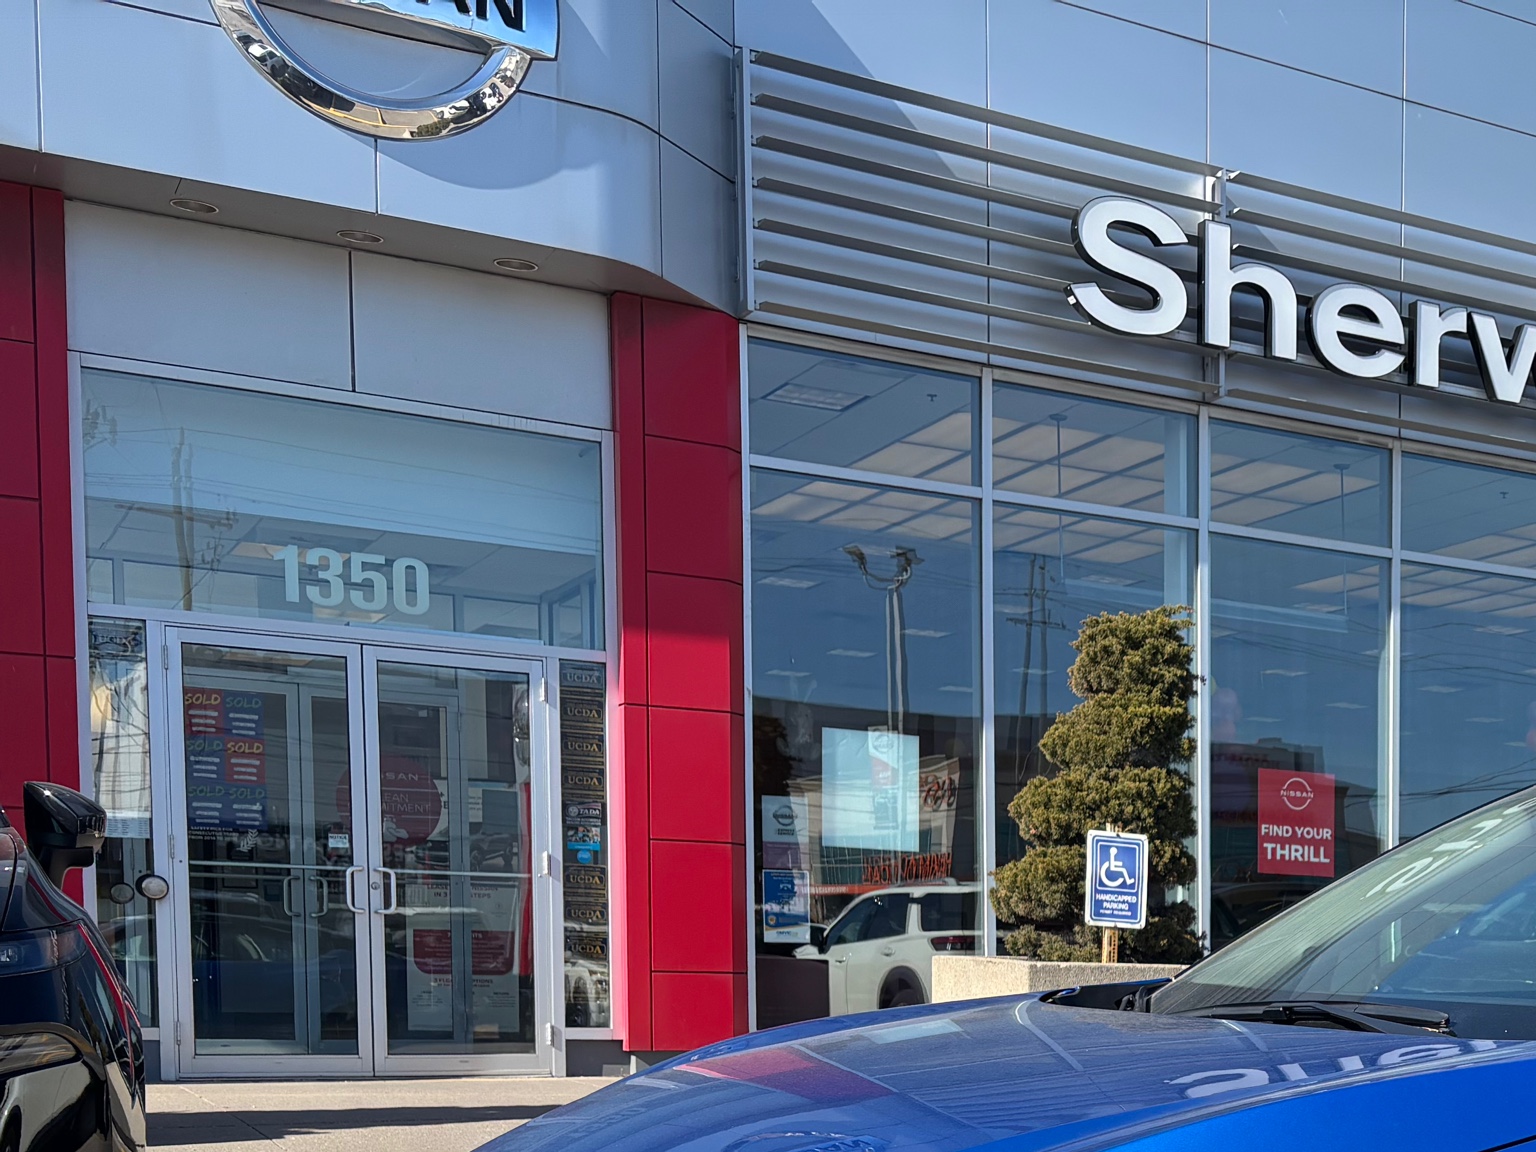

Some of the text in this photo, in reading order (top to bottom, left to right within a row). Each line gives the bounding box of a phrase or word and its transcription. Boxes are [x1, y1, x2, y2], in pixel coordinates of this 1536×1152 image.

[273, 545, 430, 615] 1350
[567, 673, 598, 683] UCDA
[185, 693, 262, 708] SOLD SOLD
[567, 707, 599, 718] UCDA
[187, 740, 263, 754] SOLD SOLD
[568, 742, 599, 752] UCDA
[568, 776, 599, 786] UCDA
[187, 786, 265, 799] SOLD SOLD
[1280, 789, 1314, 798] NISSAN
[1261, 823, 1332, 840] FIND YOUR
[1263, 843, 1331, 863] THRILL
[570, 875, 601, 885] UCDA
[1096, 893, 1137, 903] HANDICAPPED
[1103, 902, 1129, 910] PARKING
[571, 909, 601, 919] UCDA
[571, 944, 602, 954] UCDA
